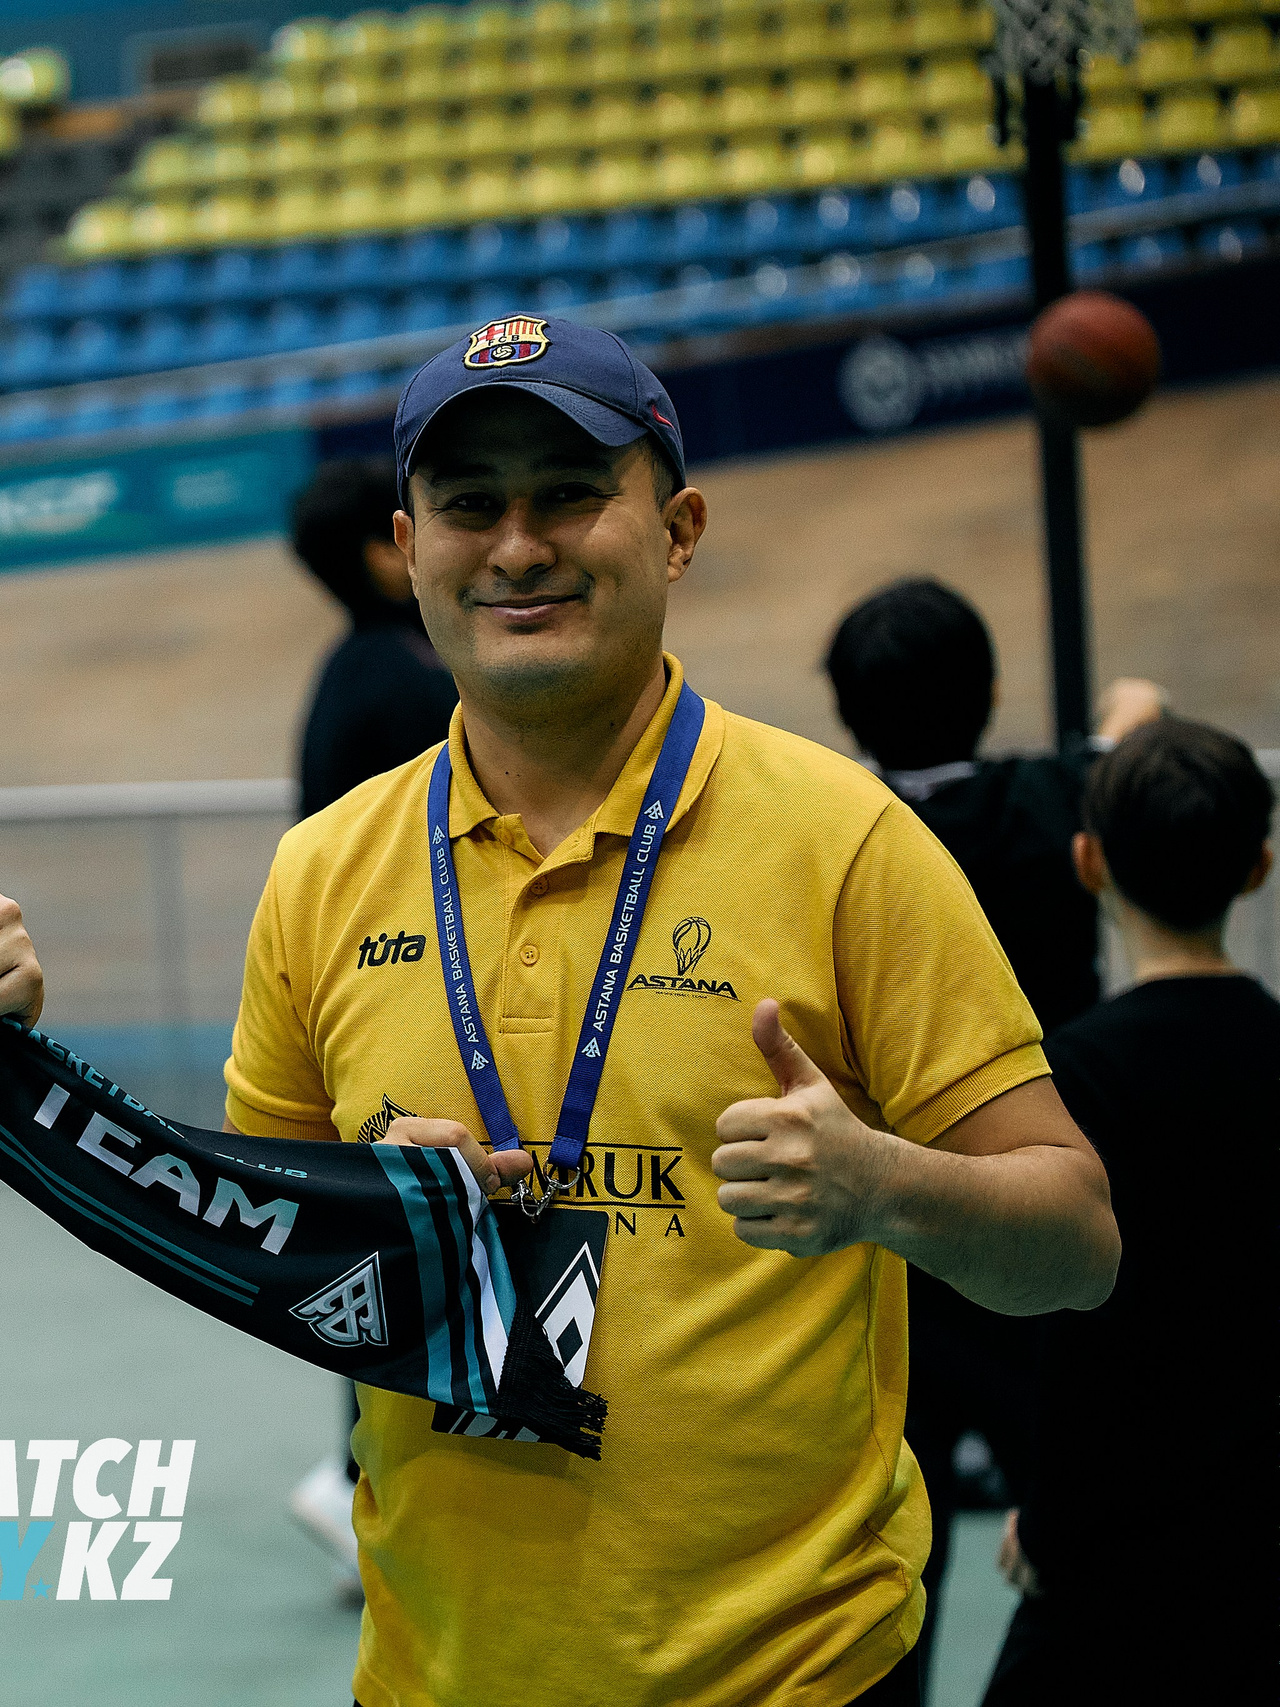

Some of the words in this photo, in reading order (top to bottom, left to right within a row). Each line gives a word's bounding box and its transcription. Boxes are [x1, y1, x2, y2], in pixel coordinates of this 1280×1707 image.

[436, 847, 450, 885] CLUB
[442, 888, 464, 981] BASKETBALL
[593, 968, 619, 1033] ASTANA
[609, 867, 646, 964] BASKETBALL
[636, 824, 657, 863] CLUB
[455, 983, 480, 1044] ASTANA
[626, 973, 739, 1000] ASTANA
